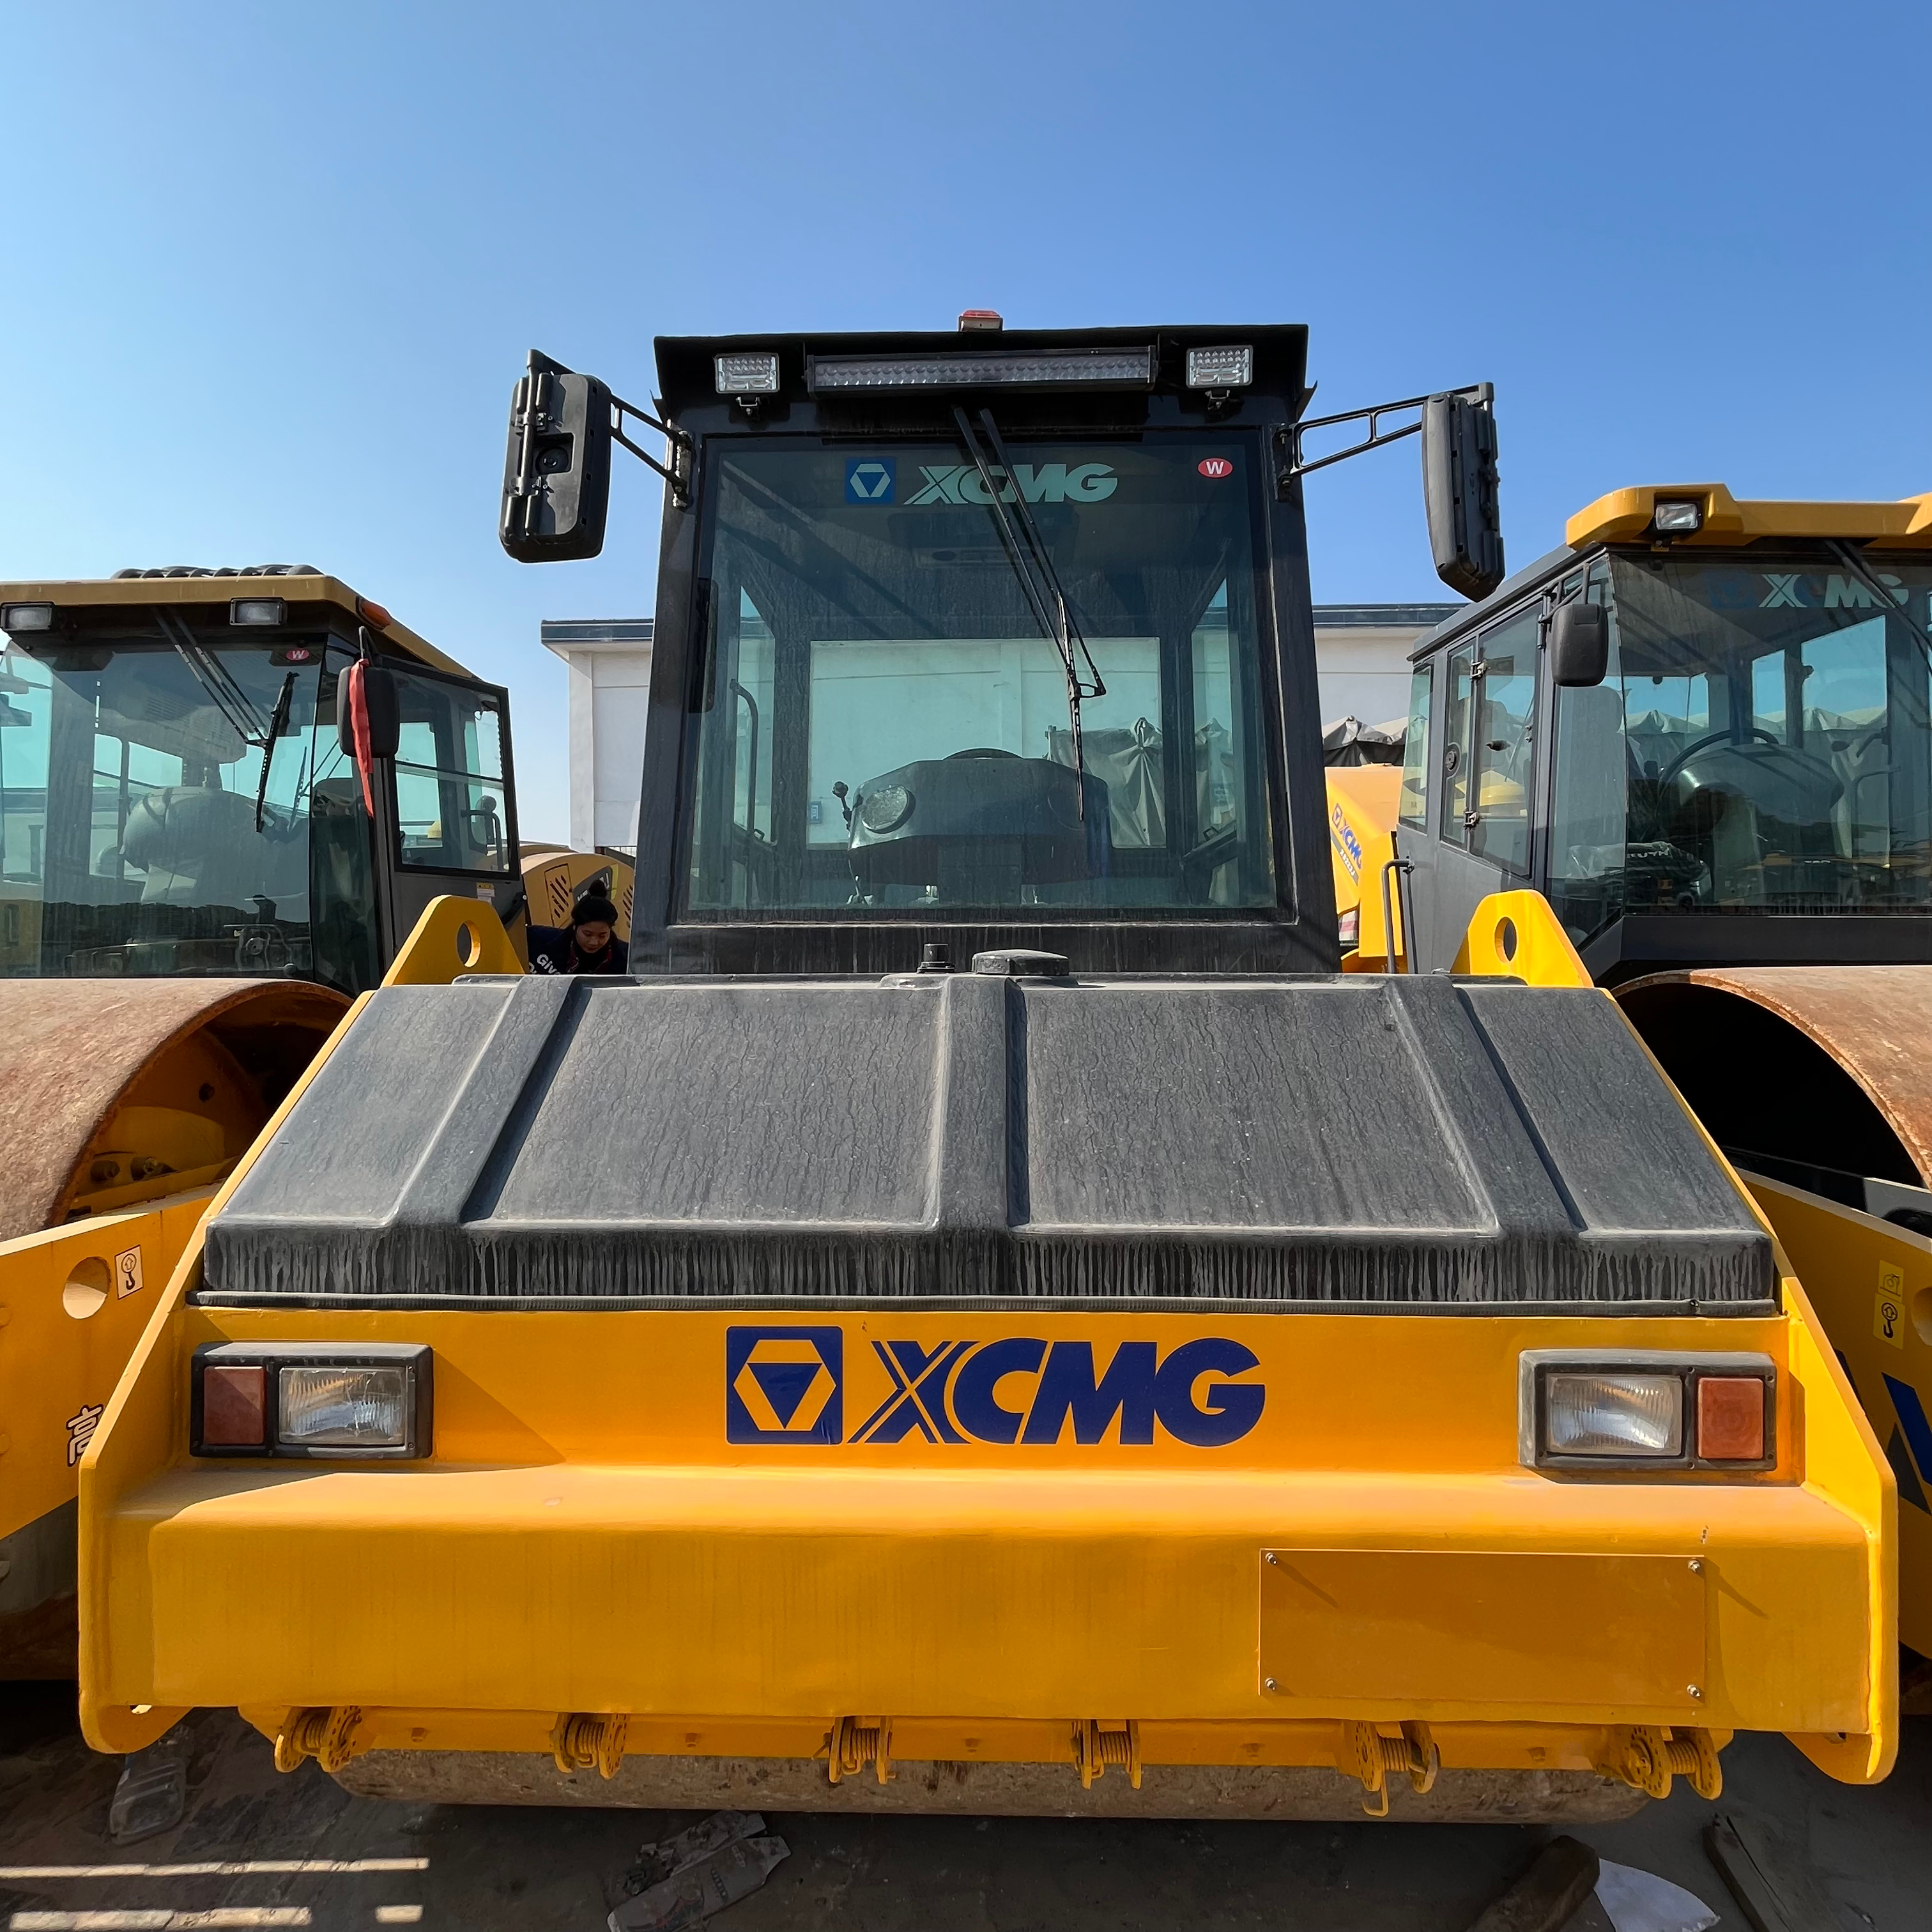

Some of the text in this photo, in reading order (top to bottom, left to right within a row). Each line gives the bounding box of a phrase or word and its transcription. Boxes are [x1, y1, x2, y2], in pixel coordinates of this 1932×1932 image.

[1206, 461, 1224, 475] W
[903, 463, 1118, 505] XCMG
[292, 650, 305, 659] W
[847, 1337, 1266, 1447] XCMG
